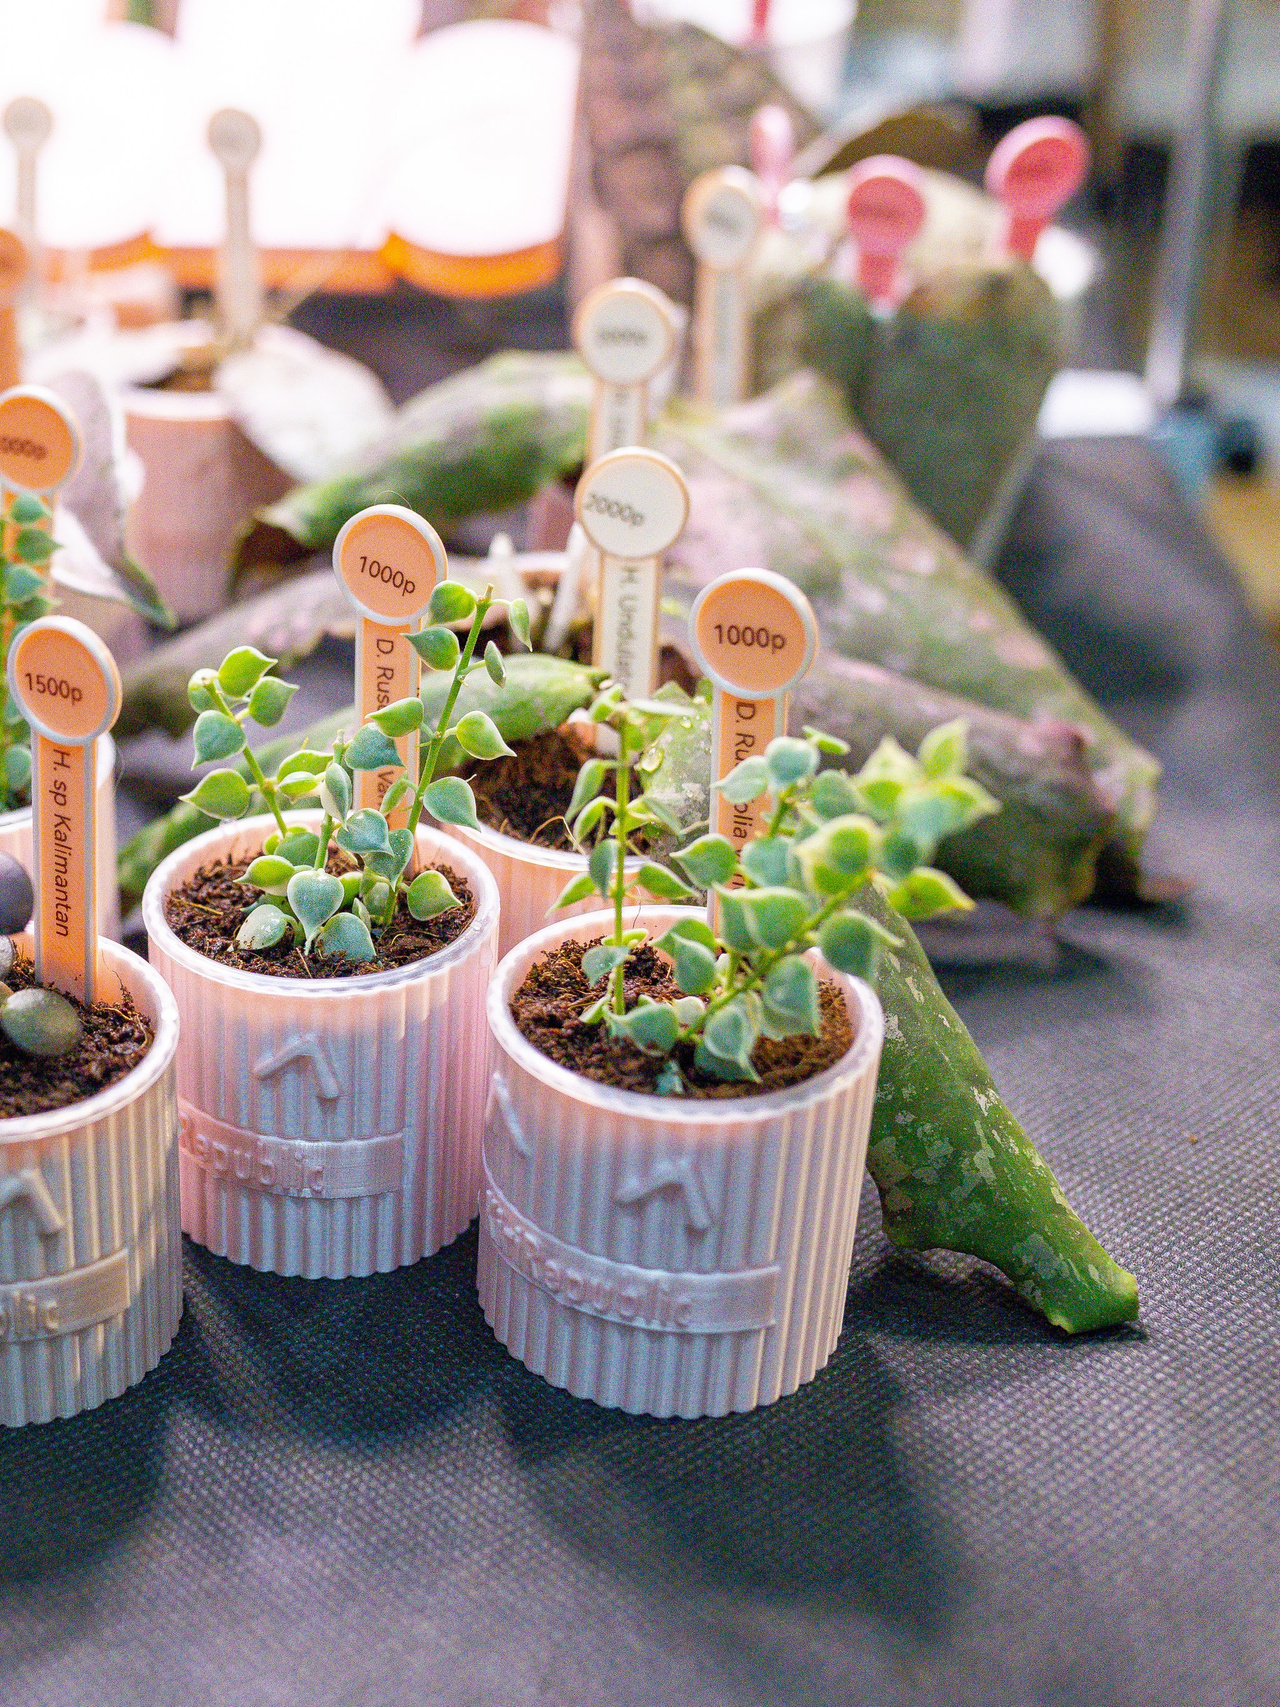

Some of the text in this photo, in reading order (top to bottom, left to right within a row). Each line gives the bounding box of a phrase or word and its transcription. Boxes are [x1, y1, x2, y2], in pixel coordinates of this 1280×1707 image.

[584, 492, 646, 527] 2000p
[357, 555, 416, 597] 1000p
[376, 638, 395, 658] D.
[713, 623, 787, 655] 1000p
[24, 671, 84, 707] 1500p
[735, 701, 756, 724] D.
[48, 748, 73, 938] H. sp Kalimantan
